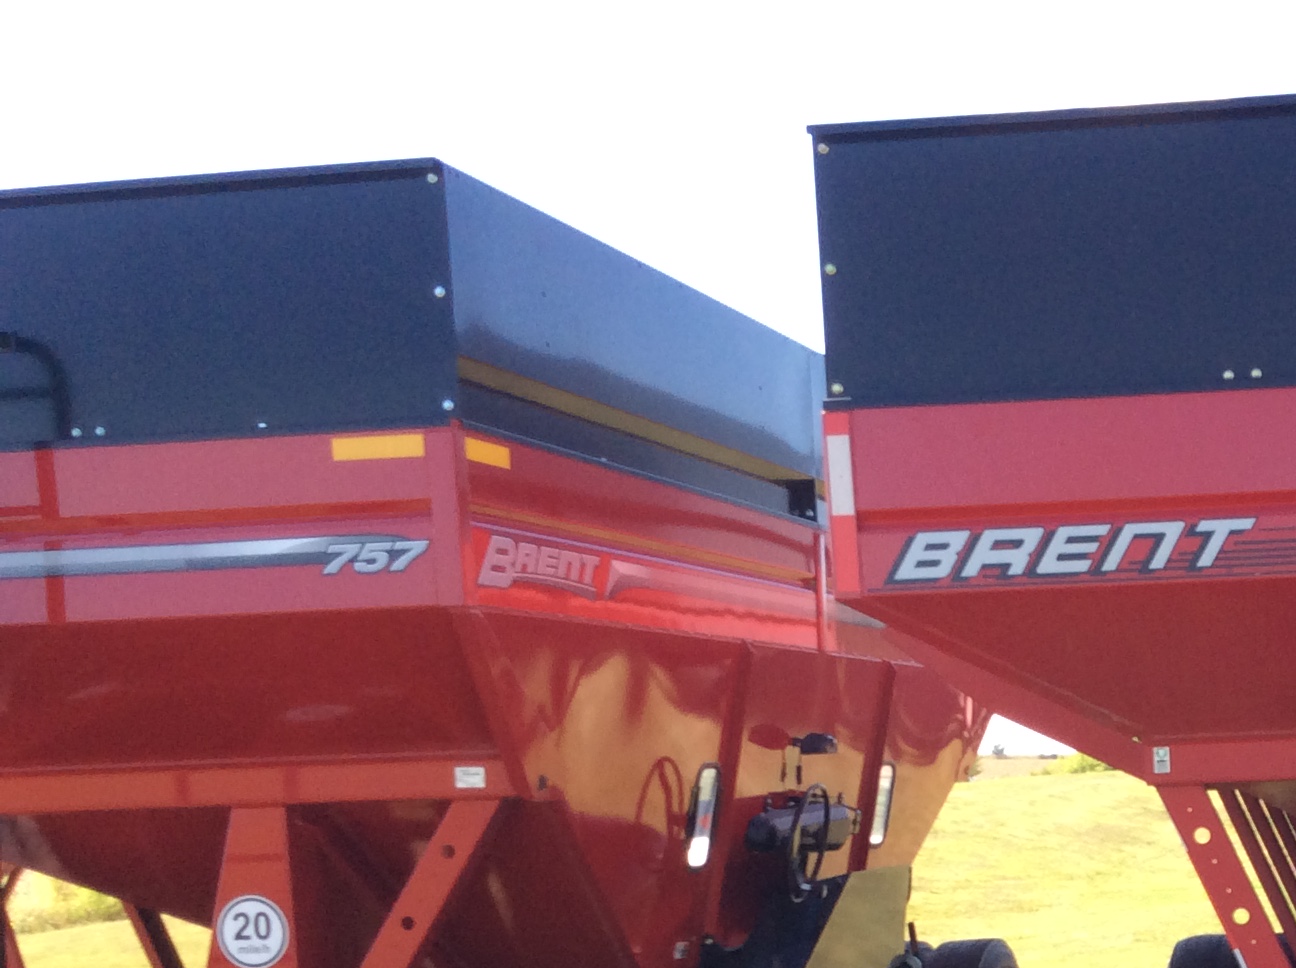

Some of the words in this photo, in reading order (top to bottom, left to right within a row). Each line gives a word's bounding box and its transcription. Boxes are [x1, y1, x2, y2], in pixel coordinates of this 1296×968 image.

[322, 539, 430, 576] 757
[477, 534, 601, 588] BRENT
[889, 517, 1258, 584] BRENT
[232, 911, 272, 941] 20
